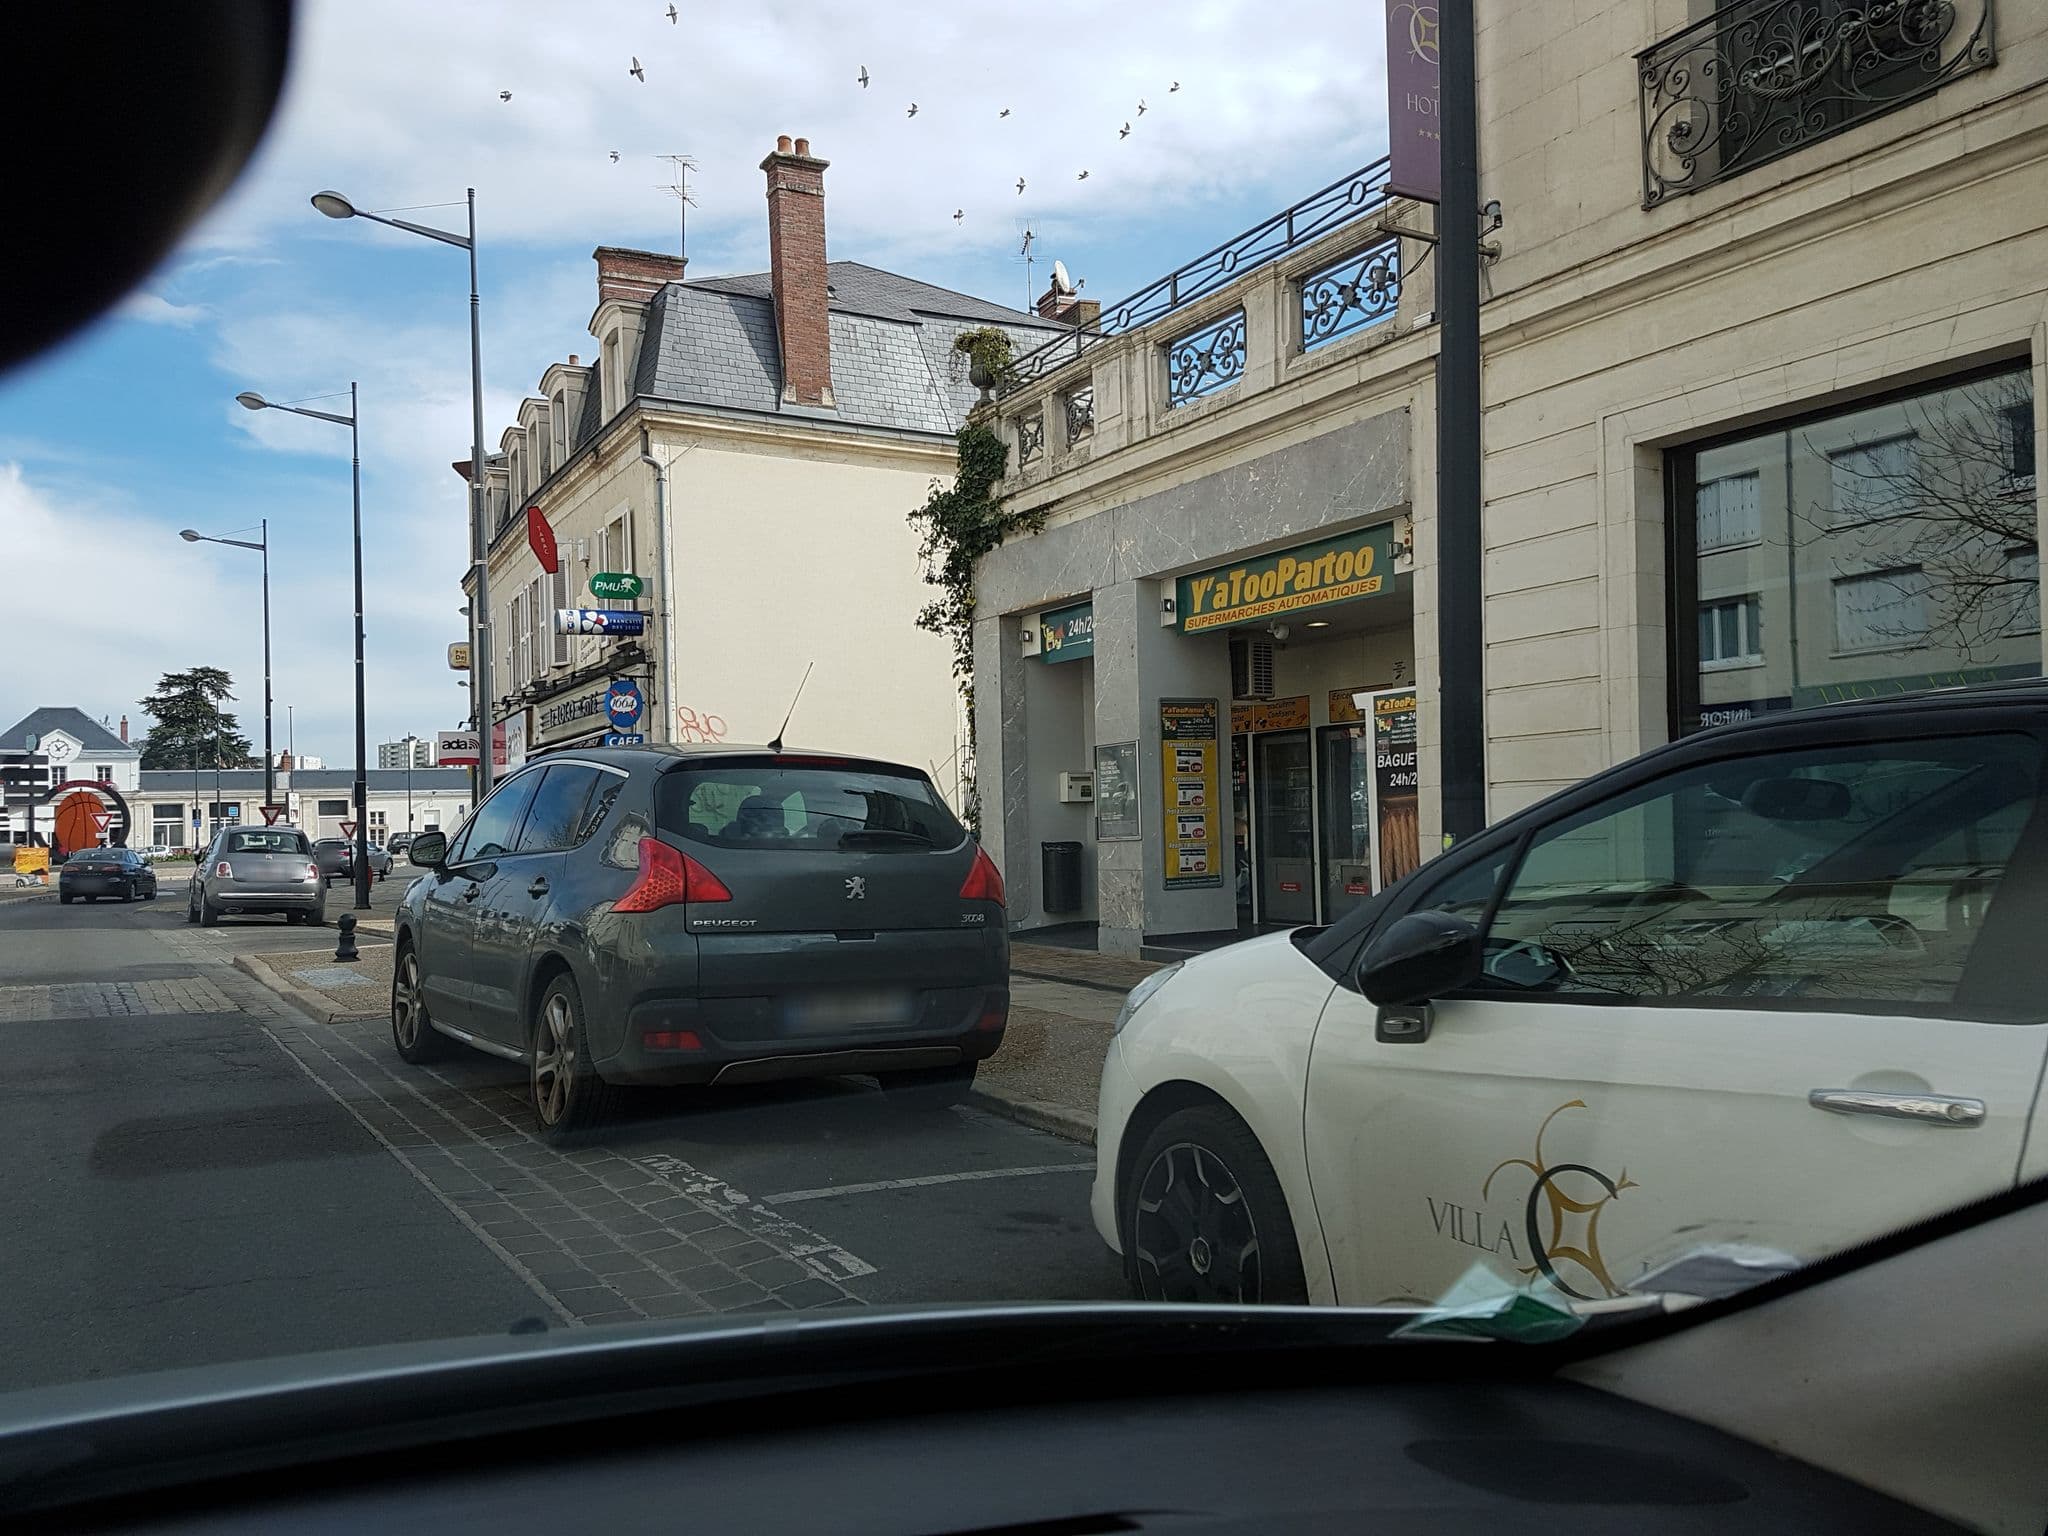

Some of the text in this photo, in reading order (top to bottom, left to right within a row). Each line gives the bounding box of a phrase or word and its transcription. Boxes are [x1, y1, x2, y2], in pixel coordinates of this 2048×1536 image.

[595, 581, 620, 592] PMU
[1190, 546, 1375, 614] Y'aTooPartoo
[1187, 579, 1377, 629] SUPERMARCHES AUTOMATIQUES
[611, 697, 636, 712] 1664
[442, 738, 468, 750] ada
[1377, 752, 1419, 769] BAGUE
[693, 919, 758, 928] PEUGEOT
[960, 912, 985, 924] 3008
[1426, 1196, 1519, 1261] VILLA
